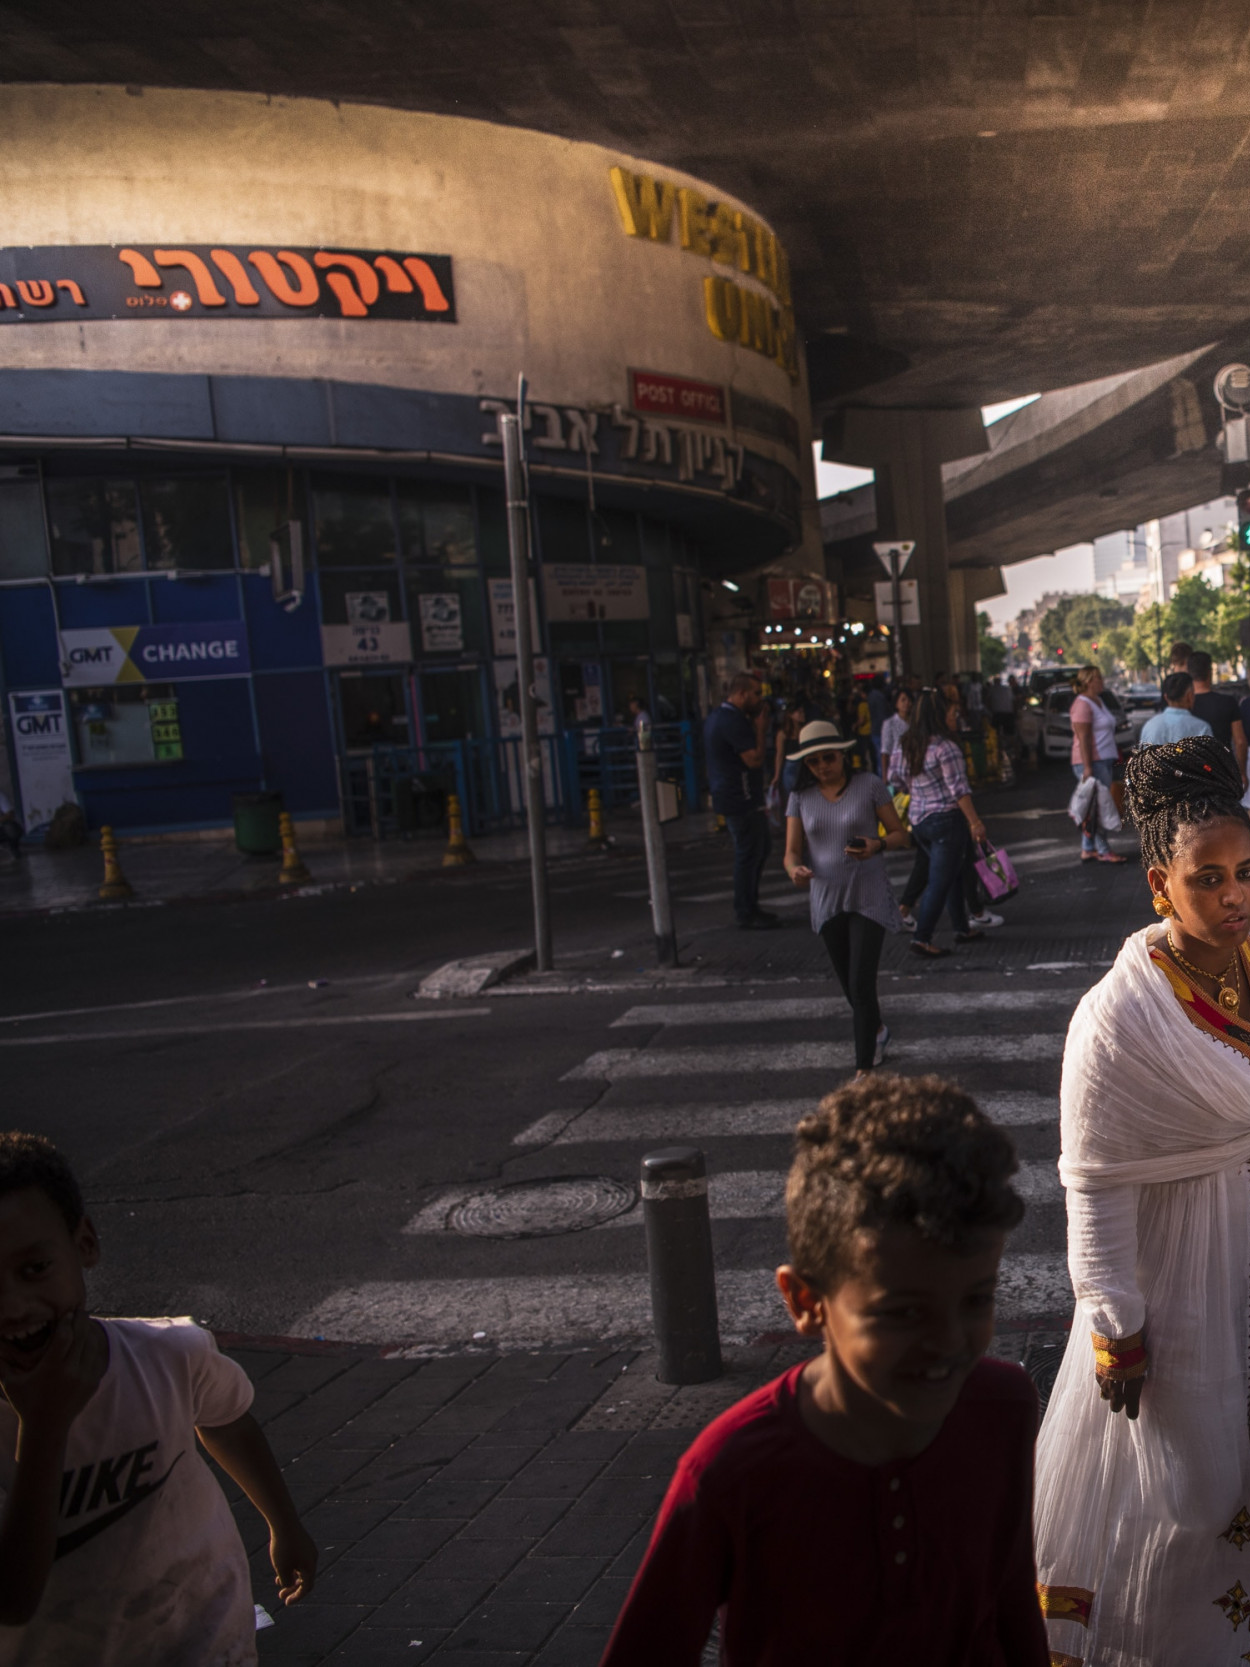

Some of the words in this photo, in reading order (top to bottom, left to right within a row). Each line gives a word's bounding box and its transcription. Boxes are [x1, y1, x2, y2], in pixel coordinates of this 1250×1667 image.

[119, 247, 450, 317] ויקטורי
[637, 382, 675, 405] POST
[681, 390, 722, 413] OFFICE
[479, 399, 599, 454] אביב
[612, 404, 673, 465] תל
[69, 646, 113, 664] GMT
[142, 640, 239, 663] CHANGE
[357, 637, 378, 651] 43
[17, 713, 62, 735] GMT
